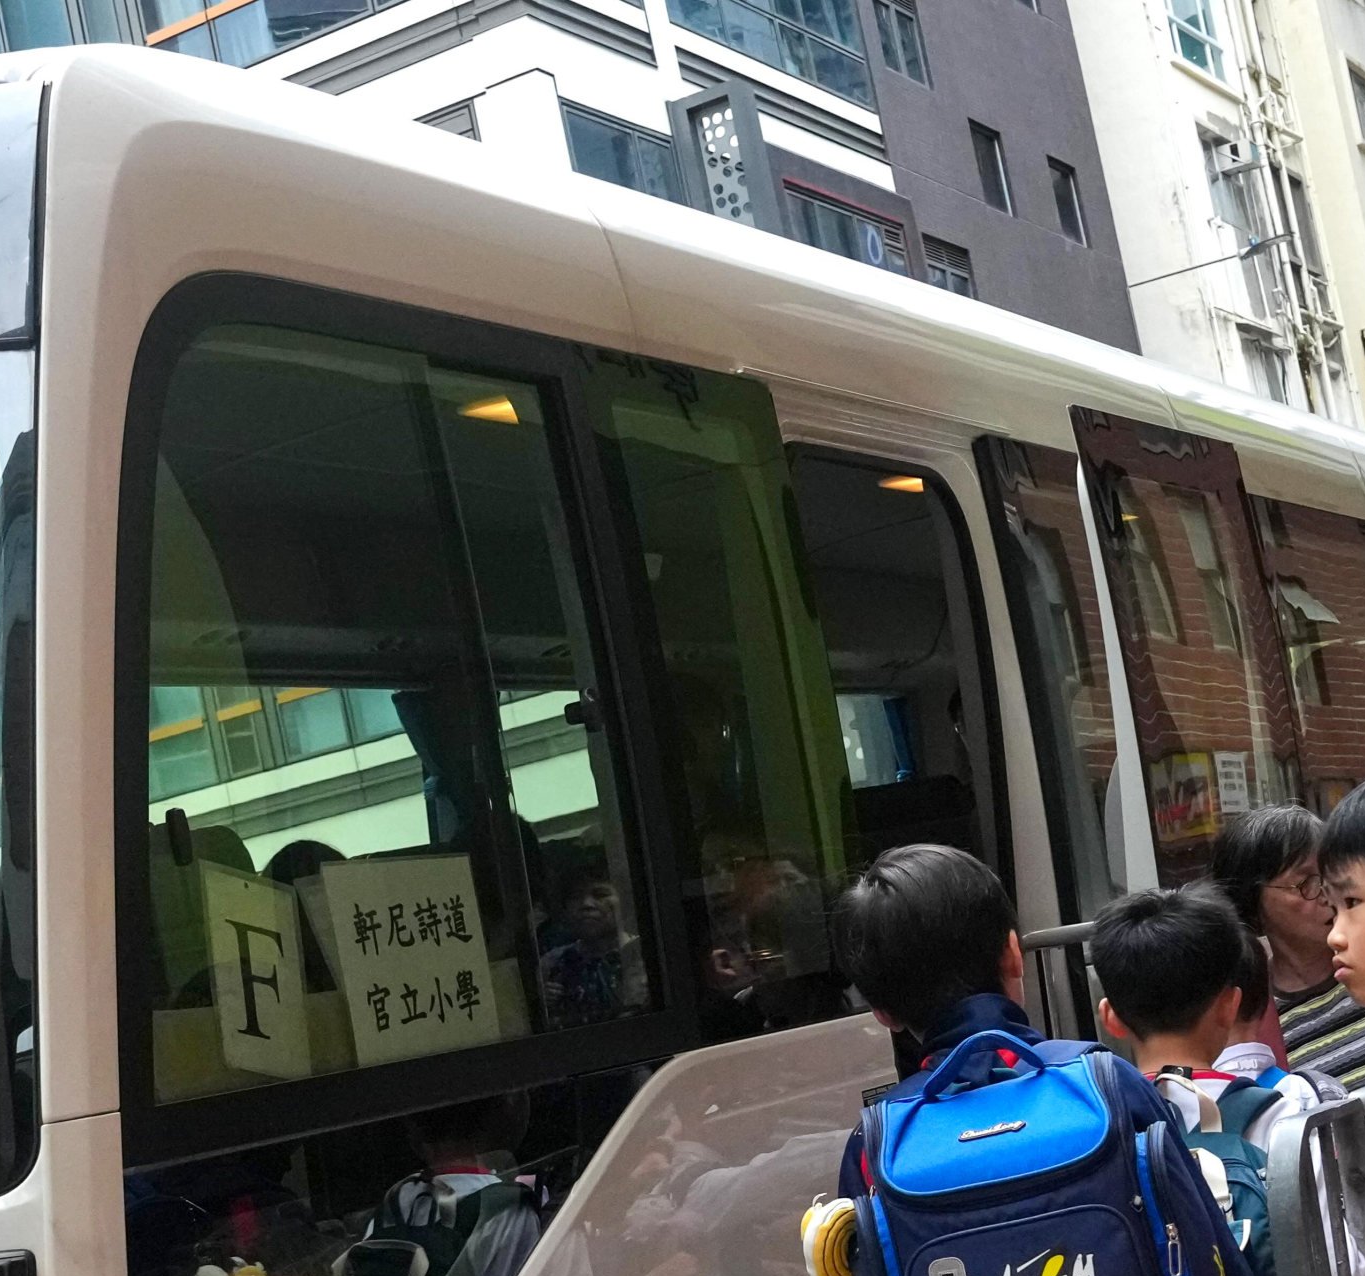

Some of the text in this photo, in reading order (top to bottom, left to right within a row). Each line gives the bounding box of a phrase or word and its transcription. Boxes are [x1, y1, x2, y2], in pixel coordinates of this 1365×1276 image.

[353, 894, 473, 956] 軒尼詩道
[224, 917, 284, 1040] F
[366, 969, 482, 1033] 官立小學
